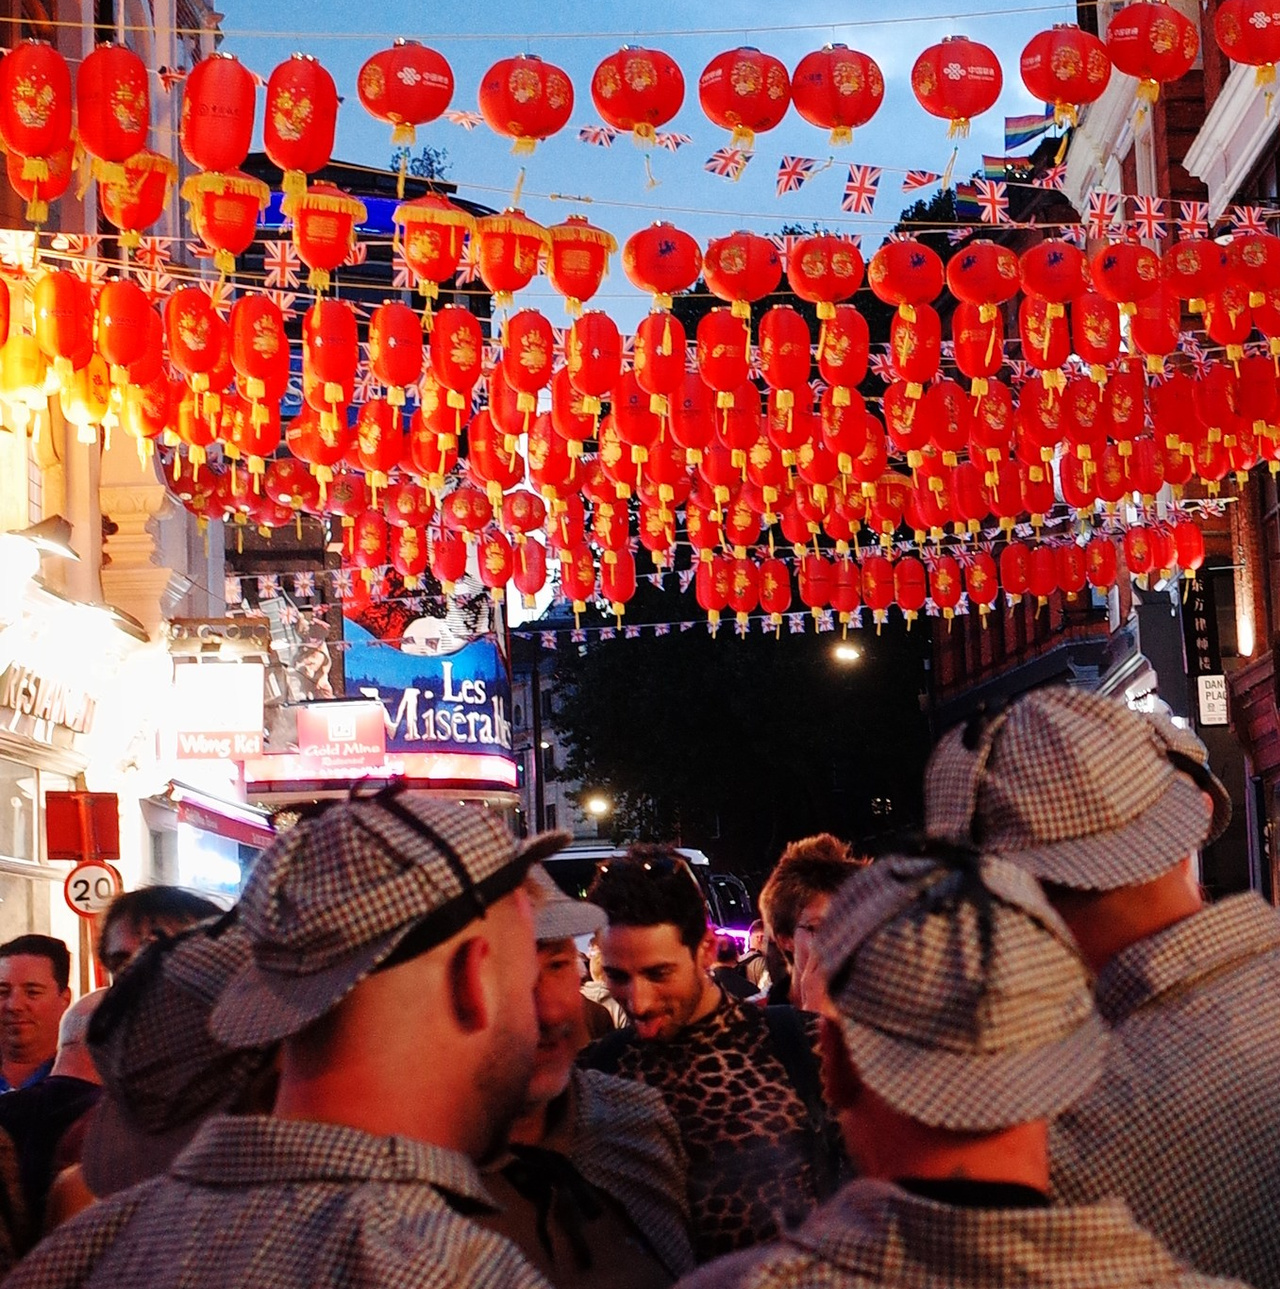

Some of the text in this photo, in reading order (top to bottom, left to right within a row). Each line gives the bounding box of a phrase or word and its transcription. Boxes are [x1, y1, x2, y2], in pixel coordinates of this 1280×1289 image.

[441, 660, 487, 704] Les
[360, 686, 512, 750] Misérabl
[304, 742, 381, 757] Gold Mine
[73, 876, 112, 902] 20
